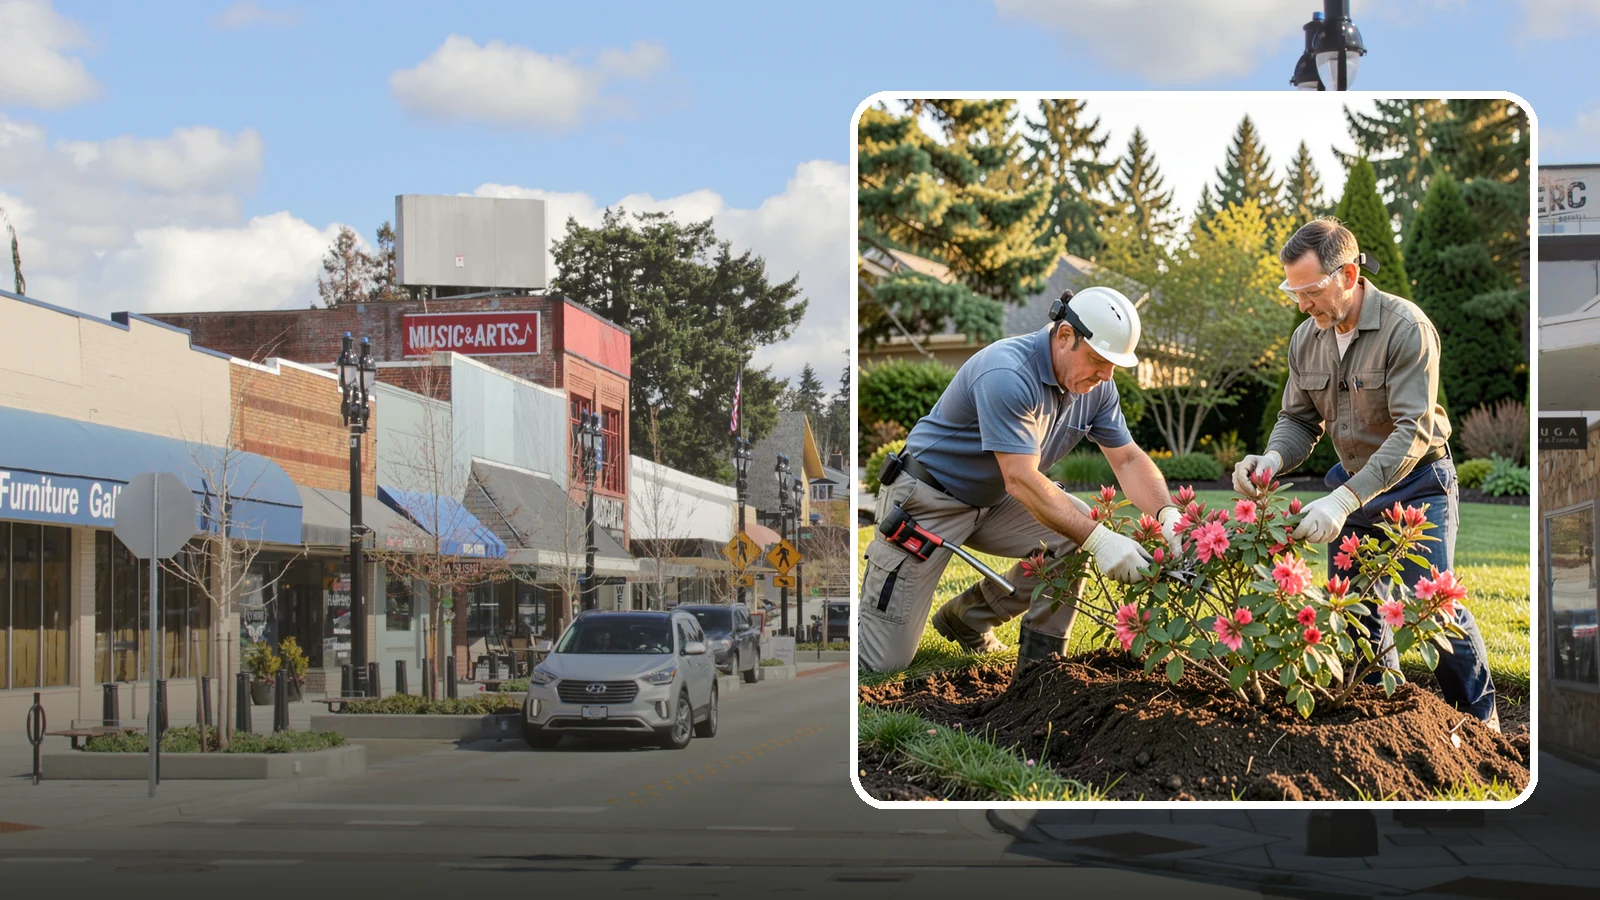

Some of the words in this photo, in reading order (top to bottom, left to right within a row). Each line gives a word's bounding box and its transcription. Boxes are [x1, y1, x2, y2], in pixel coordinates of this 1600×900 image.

[1540, 427, 1577, 437] UGA
[1551, 436, 1579, 444] Framing
[0, 471, 79, 516] Furniture
[89, 483, 122, 520] Gal
[453, 563, 479, 574] SUSHI
